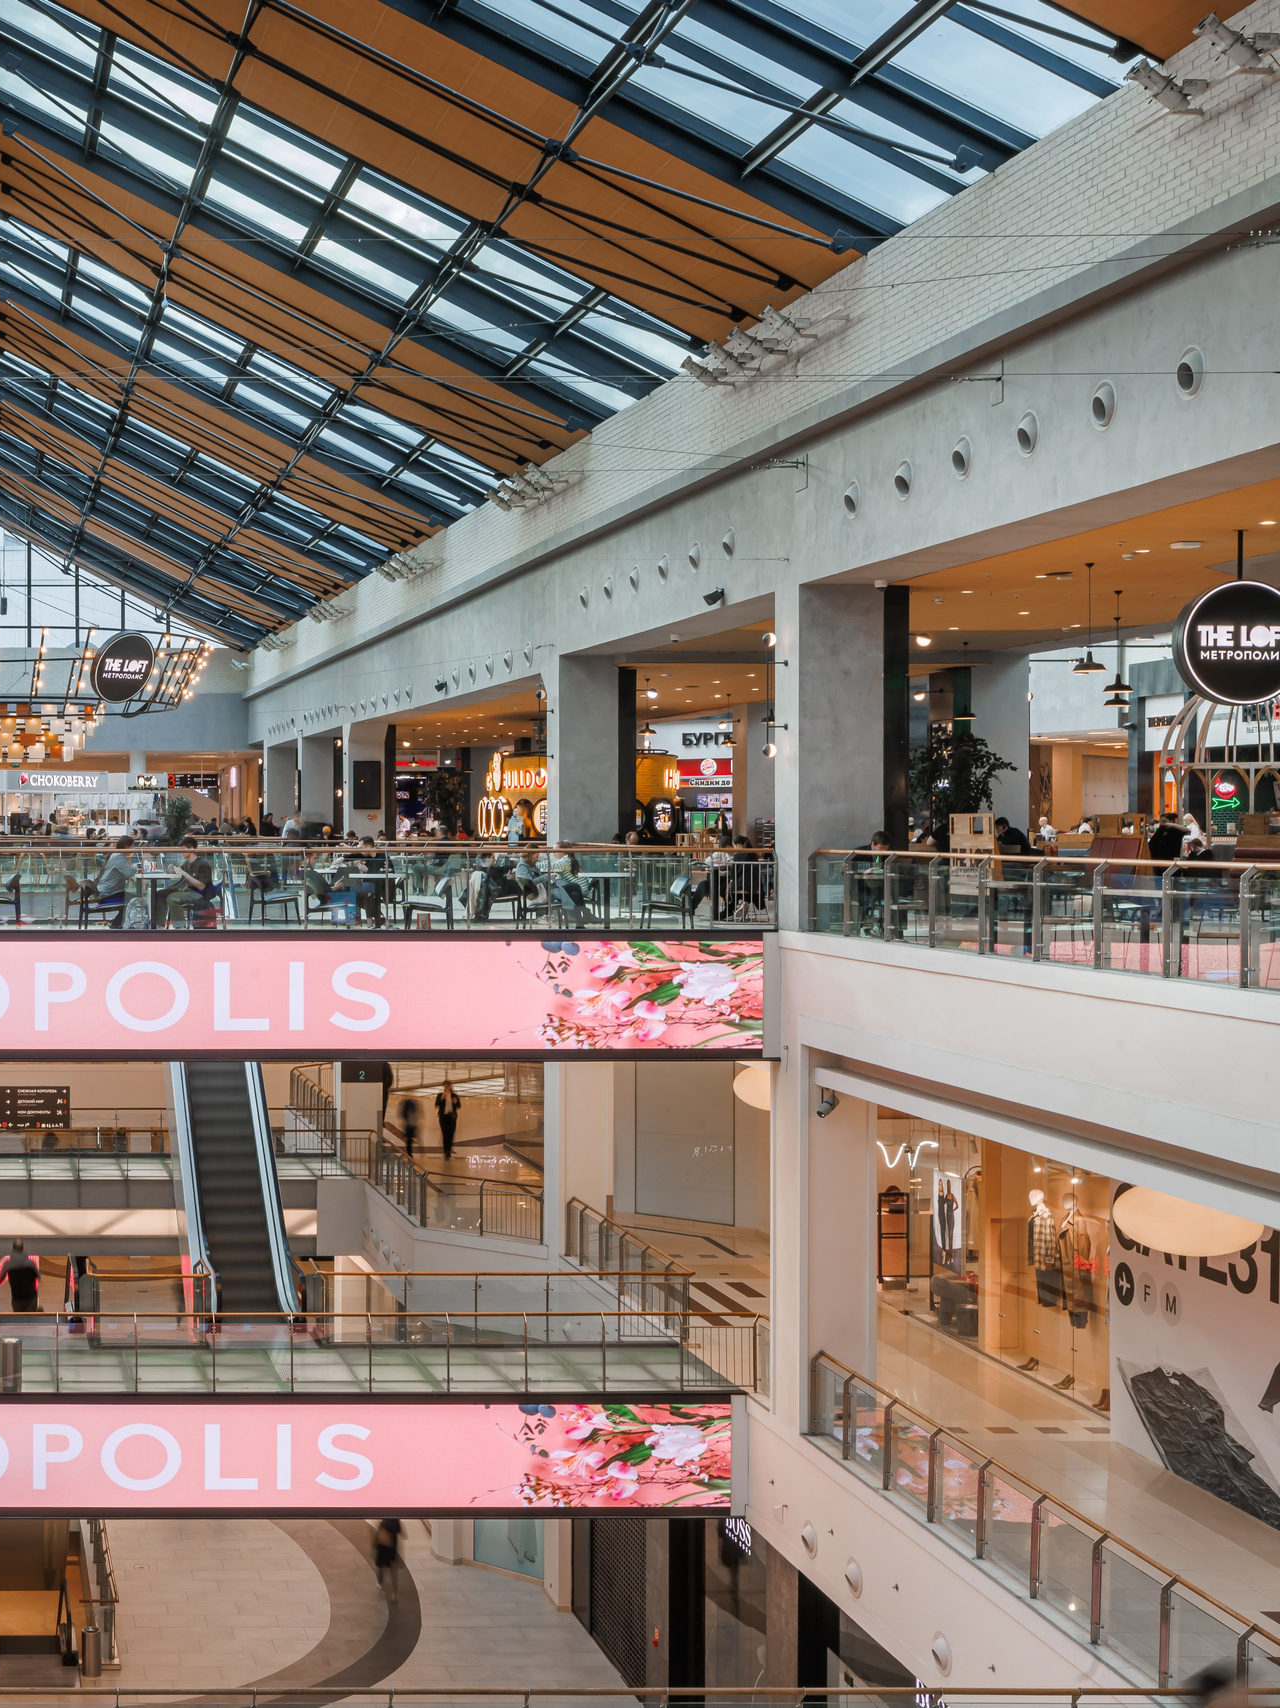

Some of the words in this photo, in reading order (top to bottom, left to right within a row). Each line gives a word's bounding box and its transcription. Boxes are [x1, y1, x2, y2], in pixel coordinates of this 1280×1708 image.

[1197, 625, 1234, 647] THE
[105, 658, 123, 672] THE
[123, 659, 149, 673] LOFT
[102, 672, 143, 680] МЕТРОПОЛИС
[29, 774, 99, 788] CHOKOBERRY
[167, 774, 176, 788] 3
[359, 1070, 365, 1080] 2
[1143, 1284, 1151, 1303] F
[1165, 1293, 1177, 1315] M
